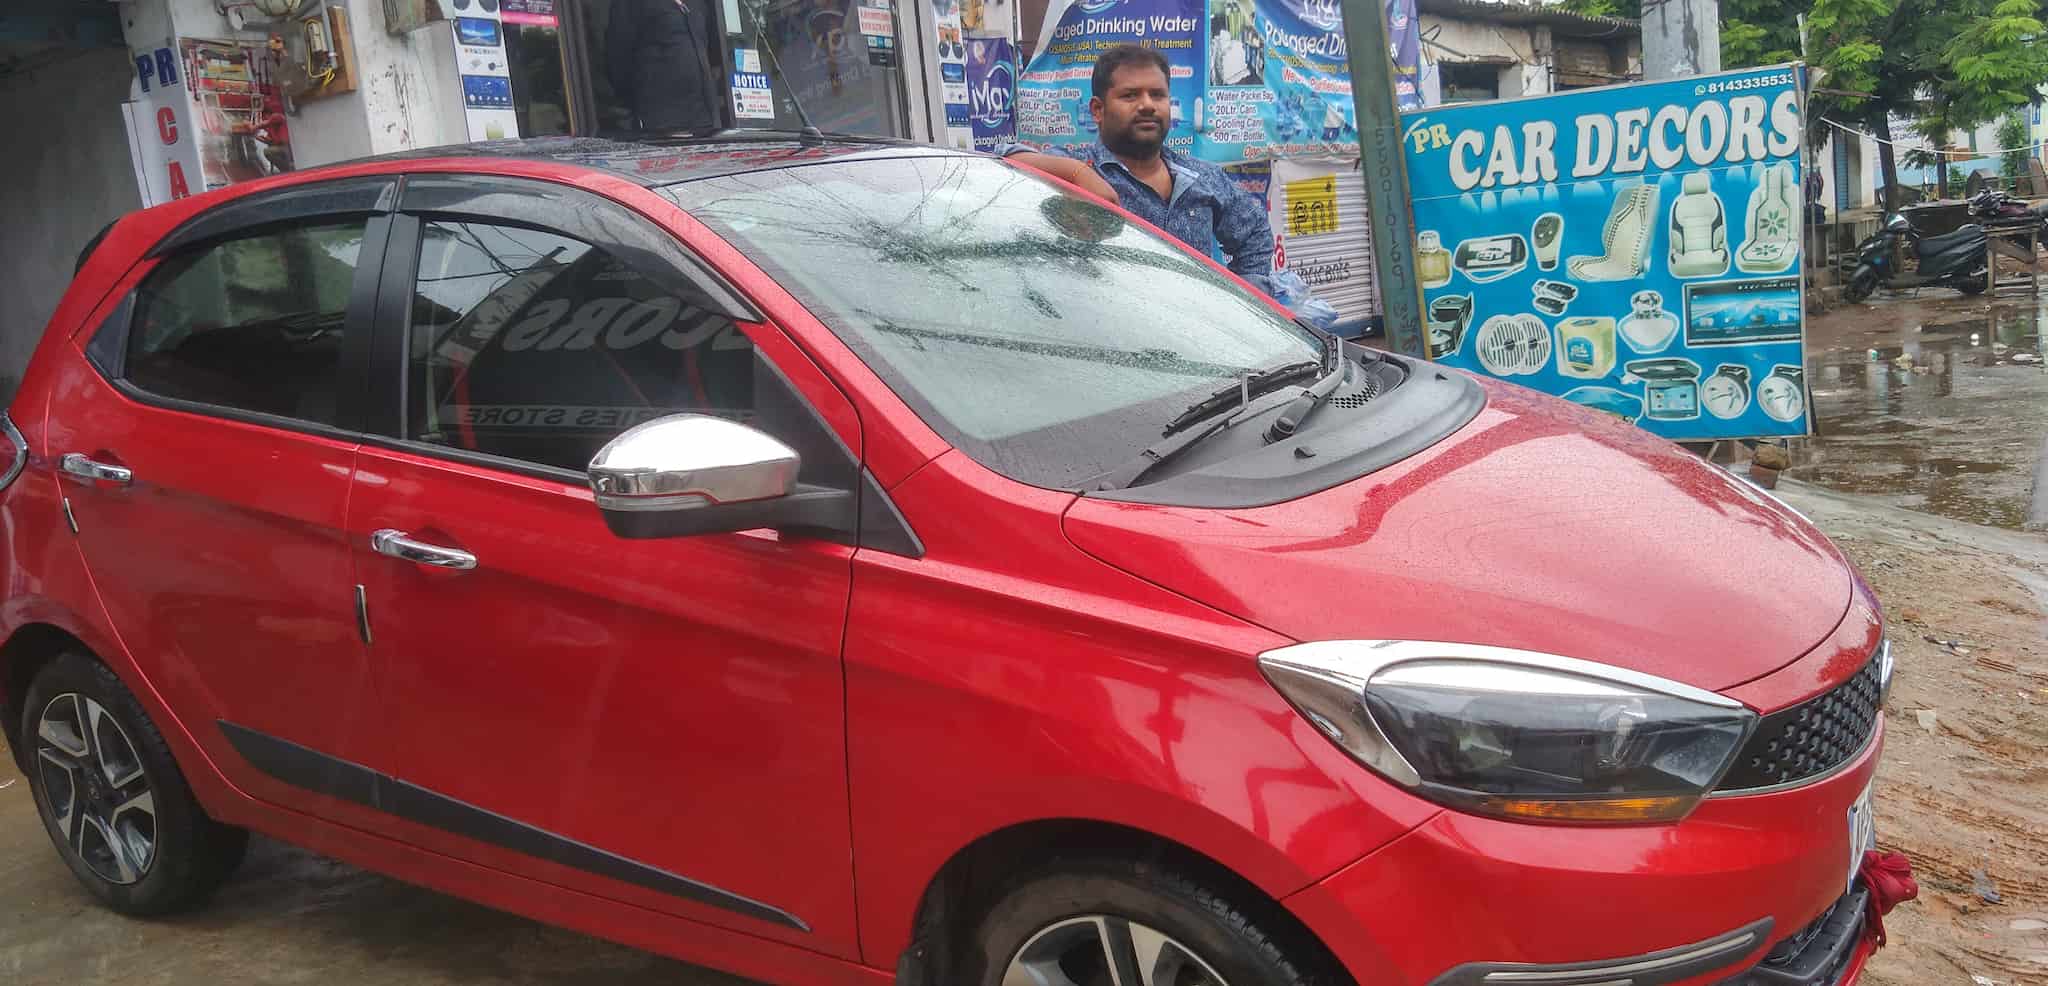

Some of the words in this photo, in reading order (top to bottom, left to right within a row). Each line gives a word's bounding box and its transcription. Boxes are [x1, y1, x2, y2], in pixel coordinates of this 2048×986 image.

[1087, 16, 1146, 37] Drinking
[1150, 15, 1197, 33] Water
[1154, 39, 1193, 49] Treatment
[136, 47, 179, 93] PR
[734, 73, 768, 90] NOTICE
[1215, 91, 1240, 102] Water
[1240, 103, 1257, 114] Cans
[1215, 118, 1246, 131] Cooling
[1168, 137, 1193, 148] good
[1213, 131, 1229, 142] 500
[1412, 123, 1452, 154] PR
[1448, 120, 1559, 191] CAR
[1572, 91, 1800, 177] DECORS
